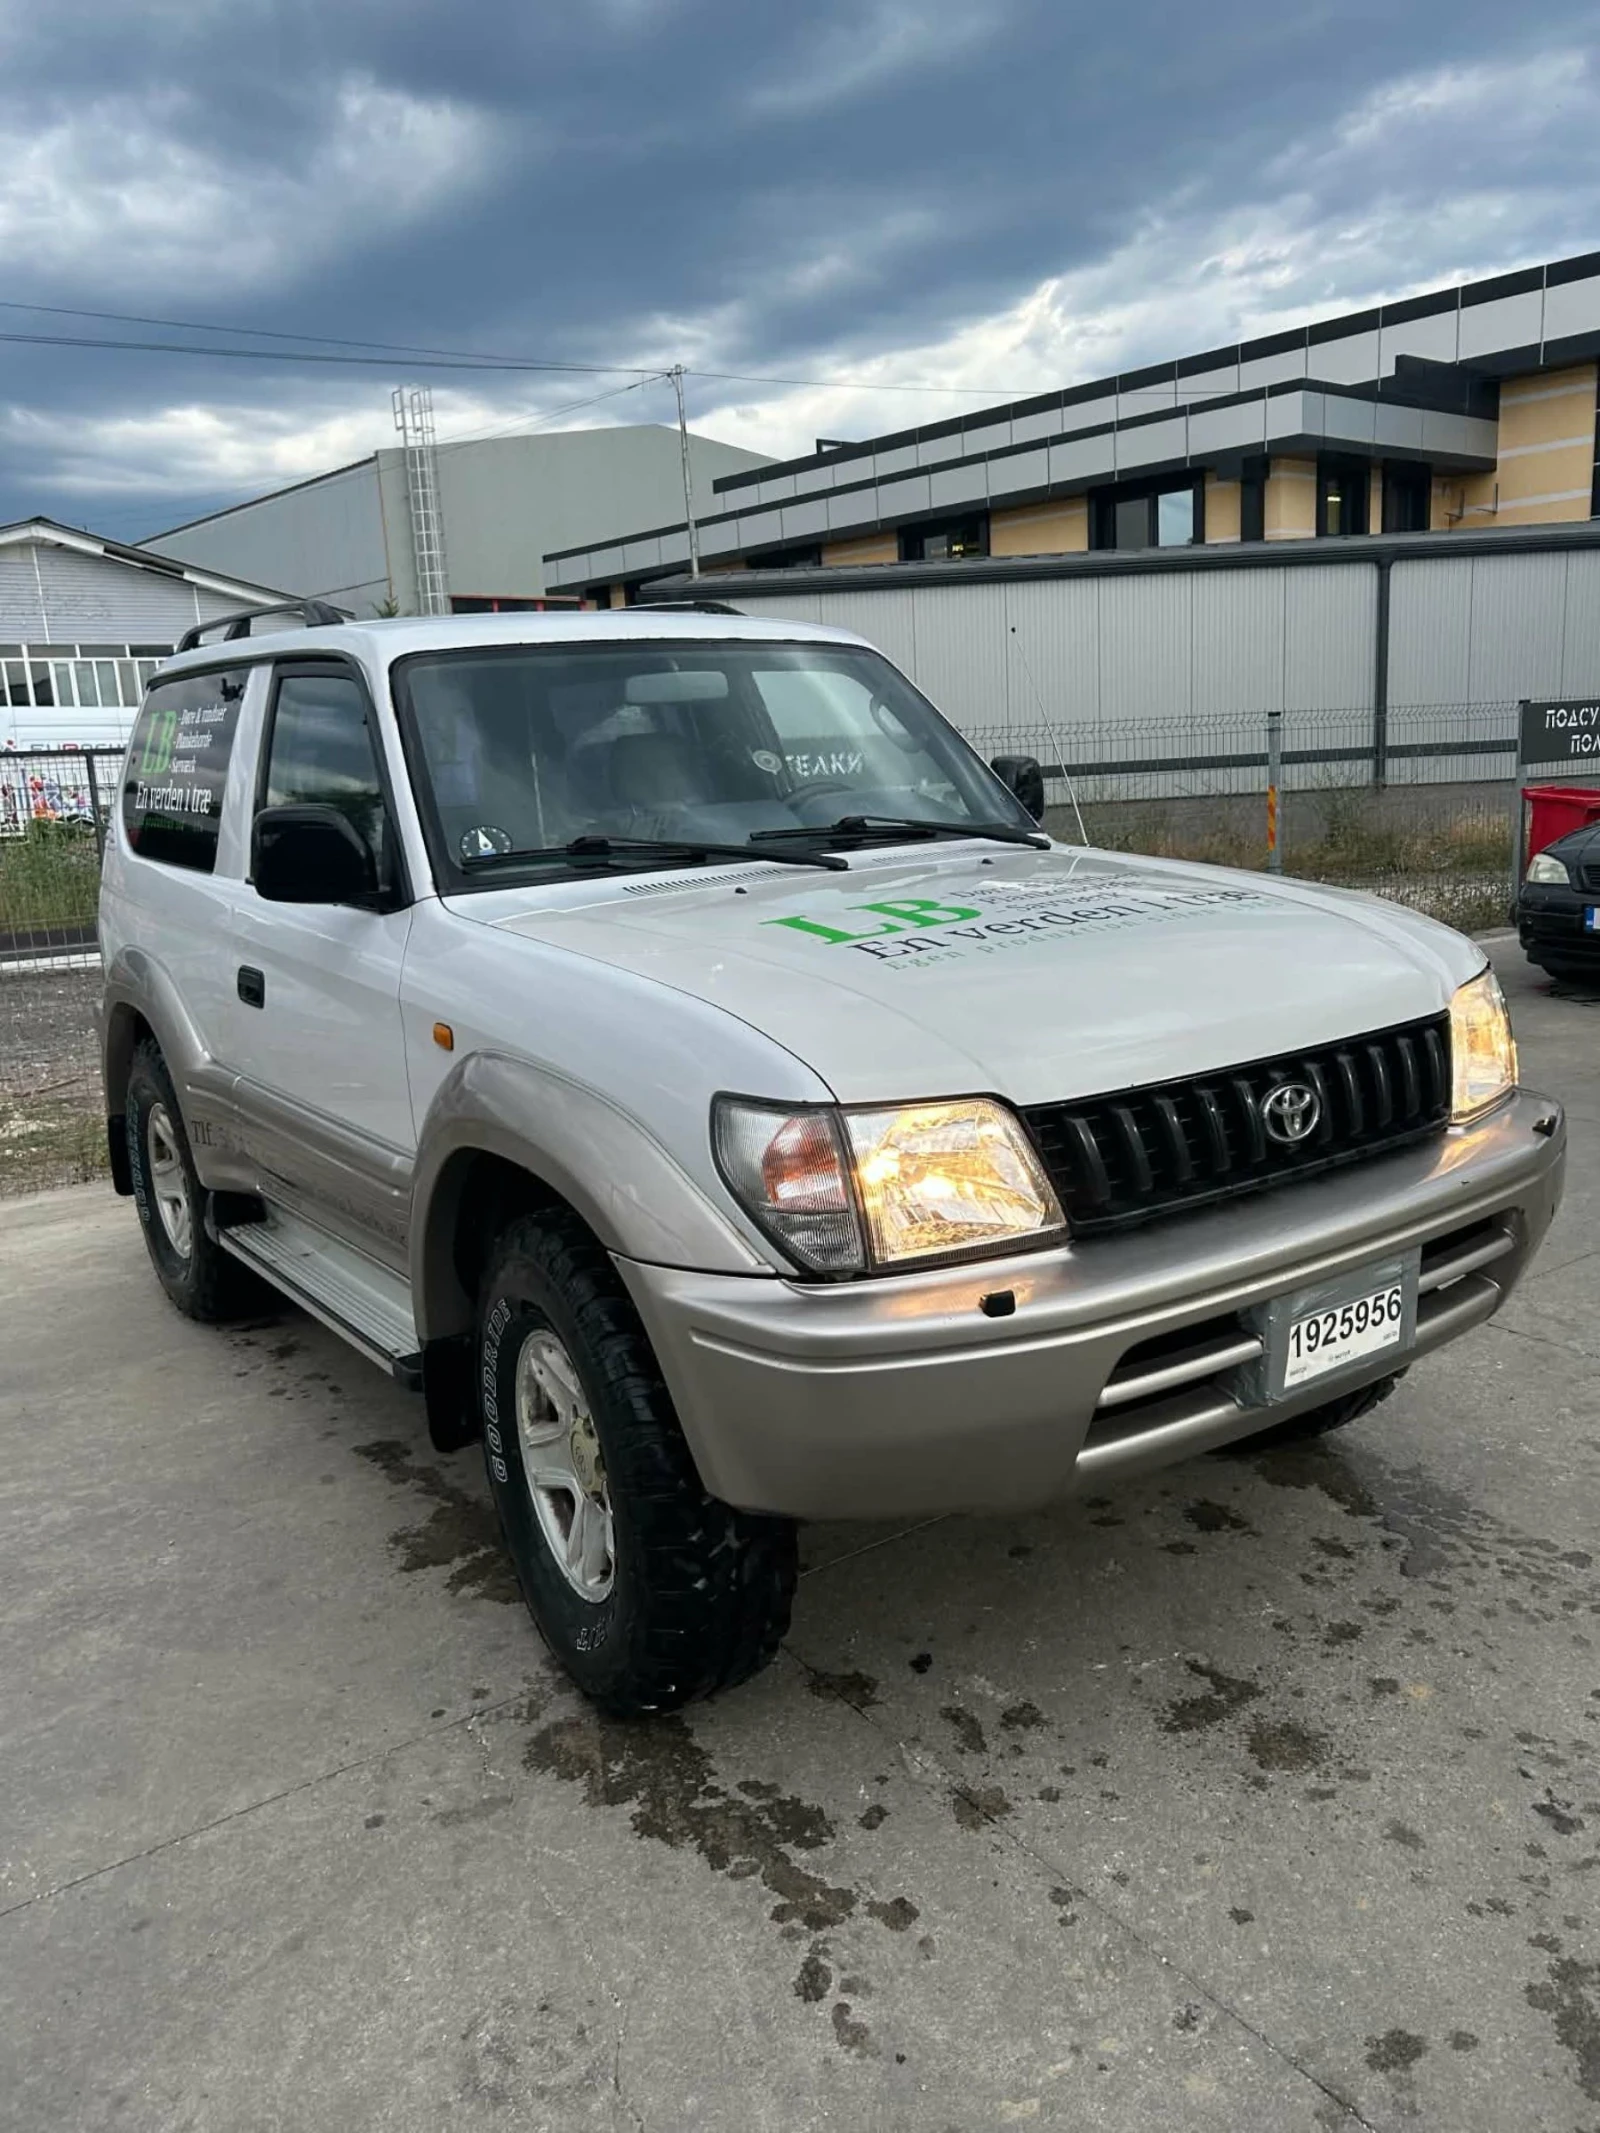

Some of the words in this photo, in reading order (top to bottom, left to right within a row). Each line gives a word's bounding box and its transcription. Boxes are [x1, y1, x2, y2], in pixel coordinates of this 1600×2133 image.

[141, 710, 177, 775] LB
[1545, 706, 1600, 729] ПОДСУ
[135, 781, 148, 809] En
[150, 779, 184, 811] verden
[184, 781, 190, 812] i
[191, 784, 212, 814] træ
[759, 899, 982, 945] LB
[846, 937, 952, 960] En
[944, 904, 1149, 940] verden
[1131, 897, 1178, 911] i
[1164, 890, 1260, 906] træ
[884, 951, 966, 971] Egen
[976, 919, 1142, 954] produktion
[1291, 1288, 1402, 1358] 1925956
[484, 1298, 512, 1483] GOODRIDE
